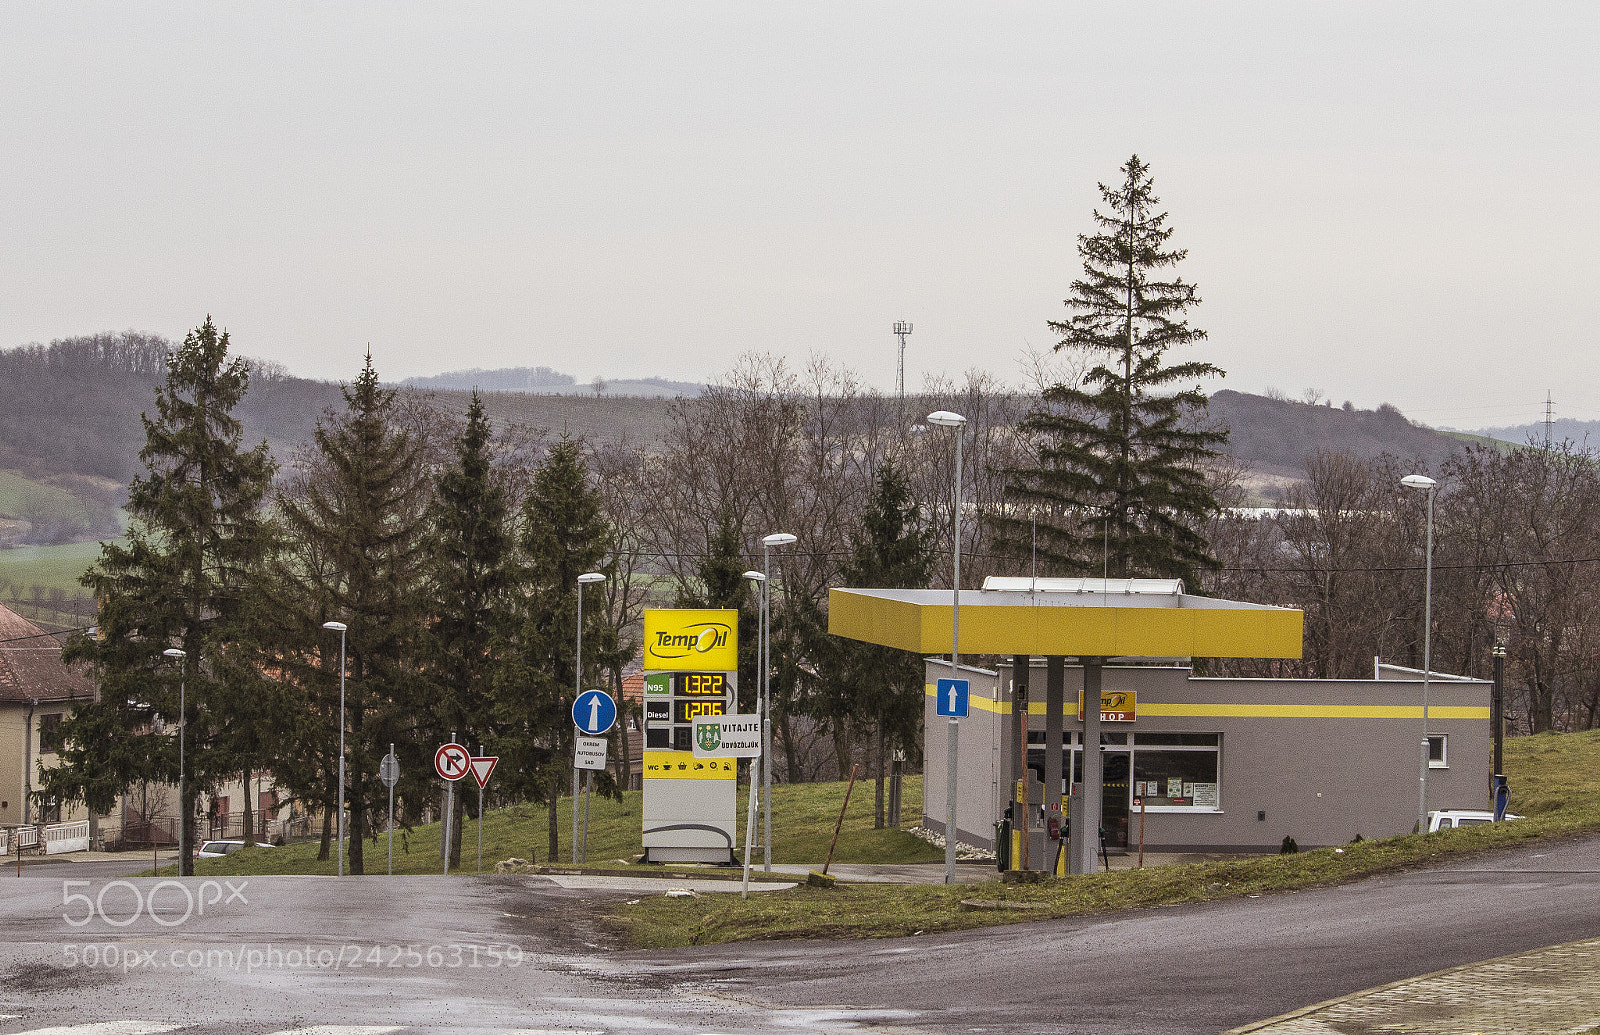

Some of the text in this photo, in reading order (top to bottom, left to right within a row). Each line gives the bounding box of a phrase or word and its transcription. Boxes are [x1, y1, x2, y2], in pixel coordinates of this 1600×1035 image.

[655, 628, 727, 653] TempOil
[647, 684, 664, 692] N95
[647, 711, 669, 719] Diesel
[722, 723, 759, 732] VITAJTE
